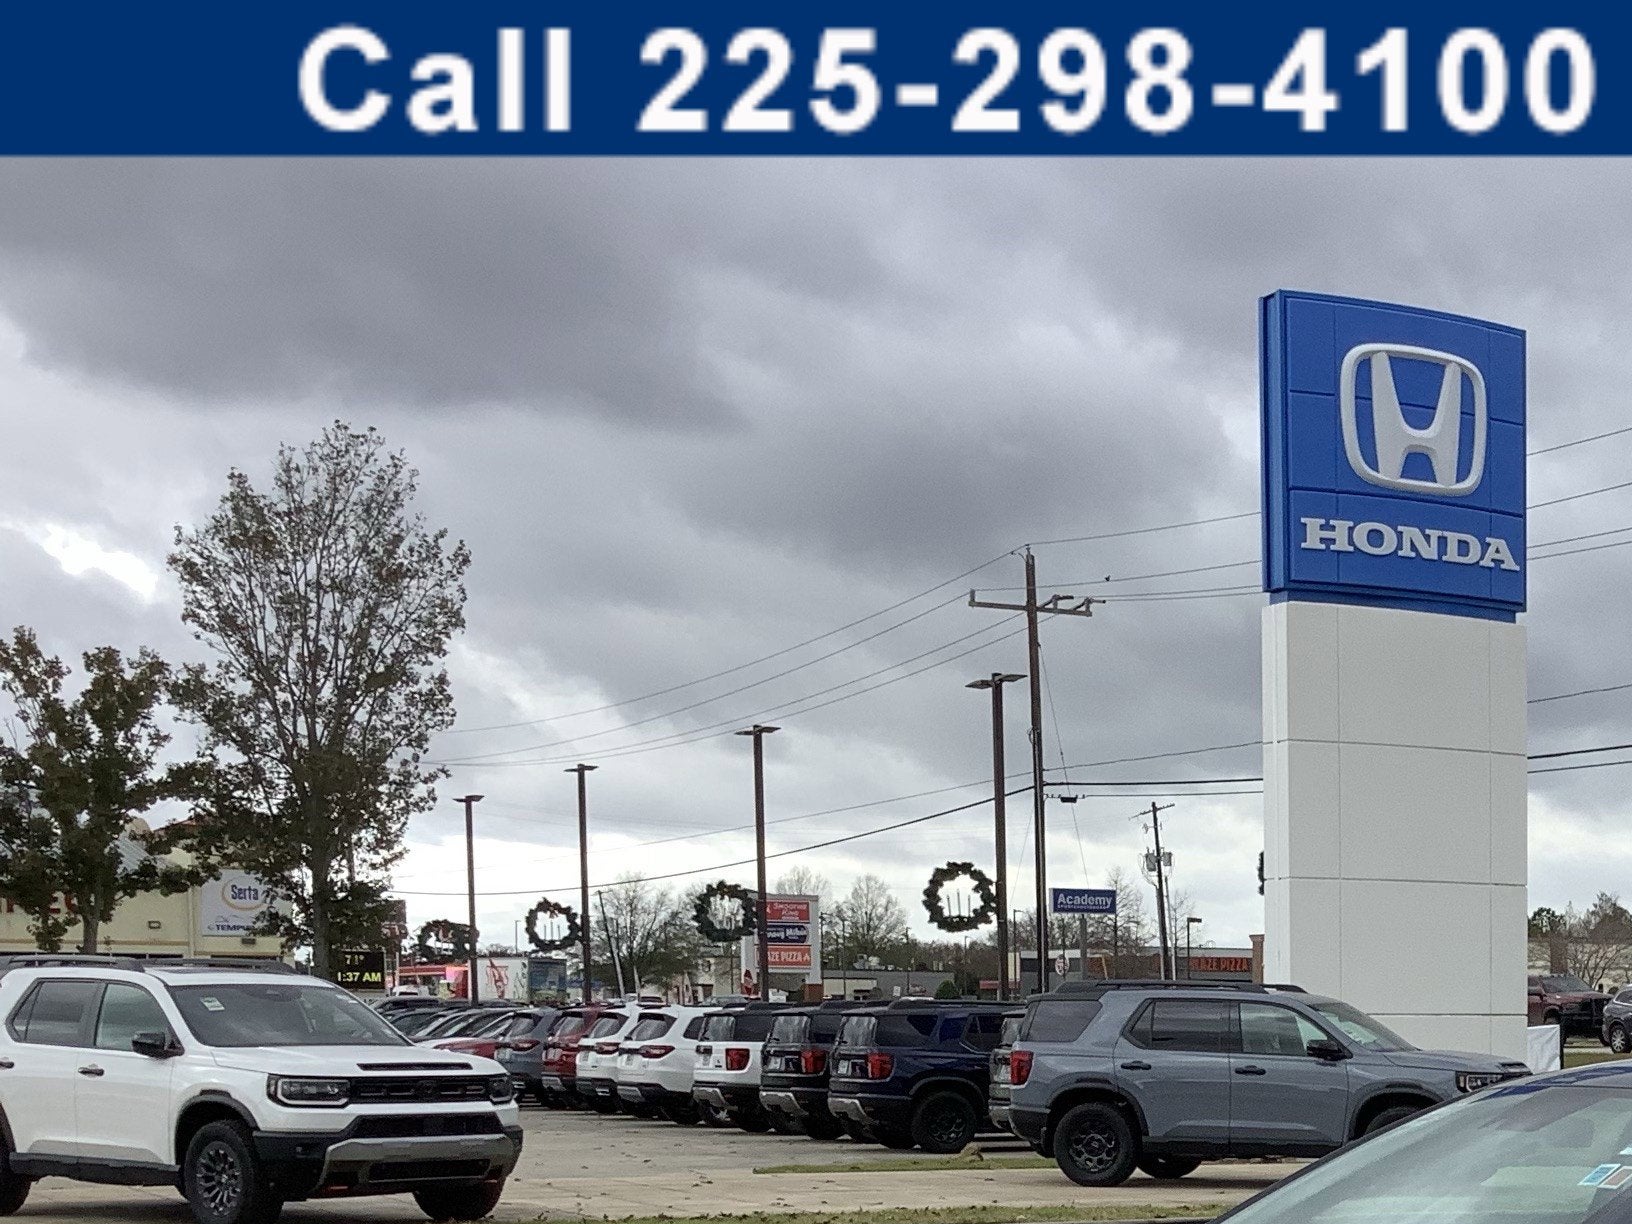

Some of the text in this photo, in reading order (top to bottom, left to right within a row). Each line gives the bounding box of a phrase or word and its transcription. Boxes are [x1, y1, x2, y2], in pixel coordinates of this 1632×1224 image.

[1300, 516, 1521, 572] HONDA
[231, 884, 259, 900] Serta
[1057, 893, 1112, 909] Academy
[362, 971, 382, 982] AM
